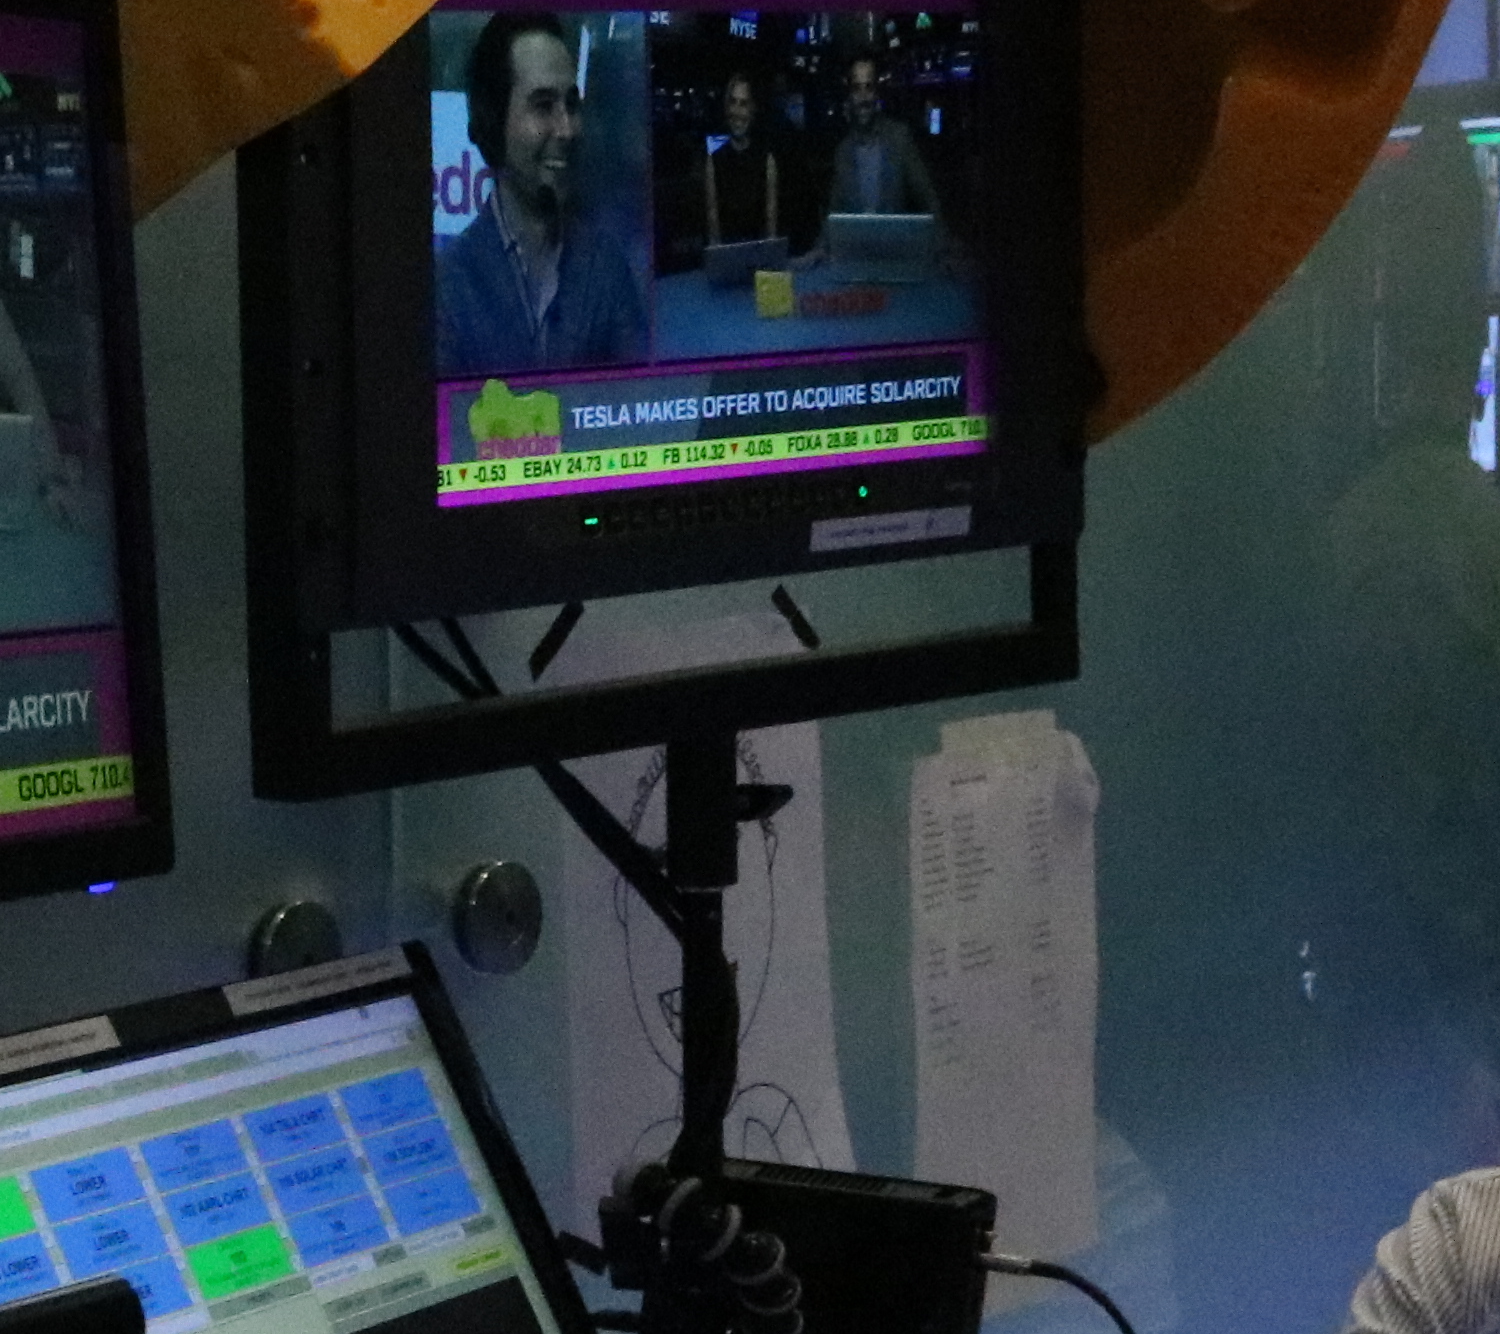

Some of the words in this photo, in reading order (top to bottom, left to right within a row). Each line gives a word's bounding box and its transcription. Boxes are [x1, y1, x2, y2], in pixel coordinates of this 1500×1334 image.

[571, 404, 630, 431] TESLA
[635, 398, 700, 425] MAKES
[702, 393, 761, 419] OFFER
[764, 390, 789, 414] TO
[792, 383, 867, 412] ACQUIRE
[870, 375, 963, 404] SOLARCITY
[473, 465, 507, 484] -0.53
[523, 458, 563, 480] EBAY
[567, 455, 602, 476] 24.73
[621, 450, 649, 469] 0.12
[663, 447, 682, 465] FB
[686, 442, 726, 464] 114.32
[787, 435, 824, 454] FOXA
[18, 770, 85, 803] GOOGL
